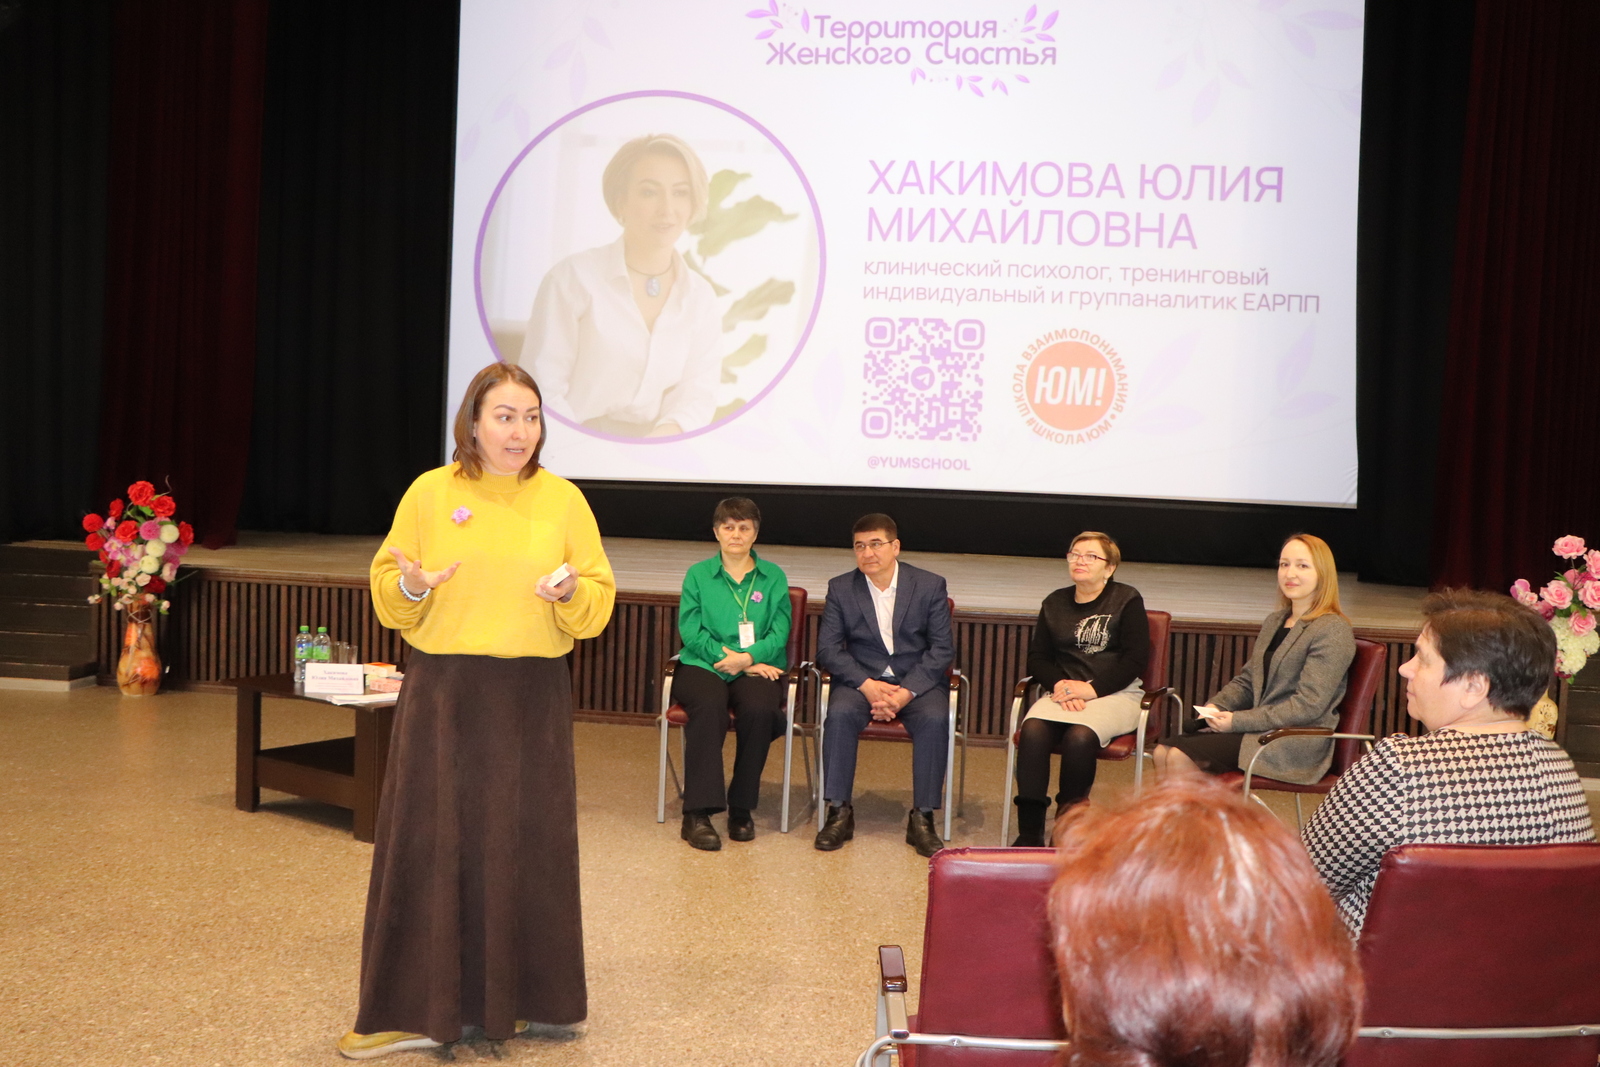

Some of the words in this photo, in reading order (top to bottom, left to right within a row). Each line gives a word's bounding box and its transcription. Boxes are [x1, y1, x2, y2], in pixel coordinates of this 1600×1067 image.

[813, 15, 997, 45] Территория
[766, 42, 911, 65] Женского
[925, 42, 1057, 65] Счастья
[867, 160, 1125, 199] ХАКИМОВА
[1139, 163, 1284, 203] ЮЛИЯ
[866, 199, 1198, 249] МИХАЙЛОВНА
[863, 260, 1002, 278] клинический
[1007, 262, 1112, 283] психолог,
[1119, 266, 1269, 287] тренинговый
[863, 283, 1045, 306] индивидуальный
[1050, 290, 1064, 304] и
[1069, 290, 1237, 311] группаналитик
[1243, 292, 1320, 314] ЕАРПП
[1021, 328, 1128, 413] ВЗАИМОПОНИМАНИЯ
[1034, 365, 1107, 406] ЮМ!
[1012, 363, 1031, 417] ШКОЛА
[867, 455, 971, 471] @YUMSCHOOL
